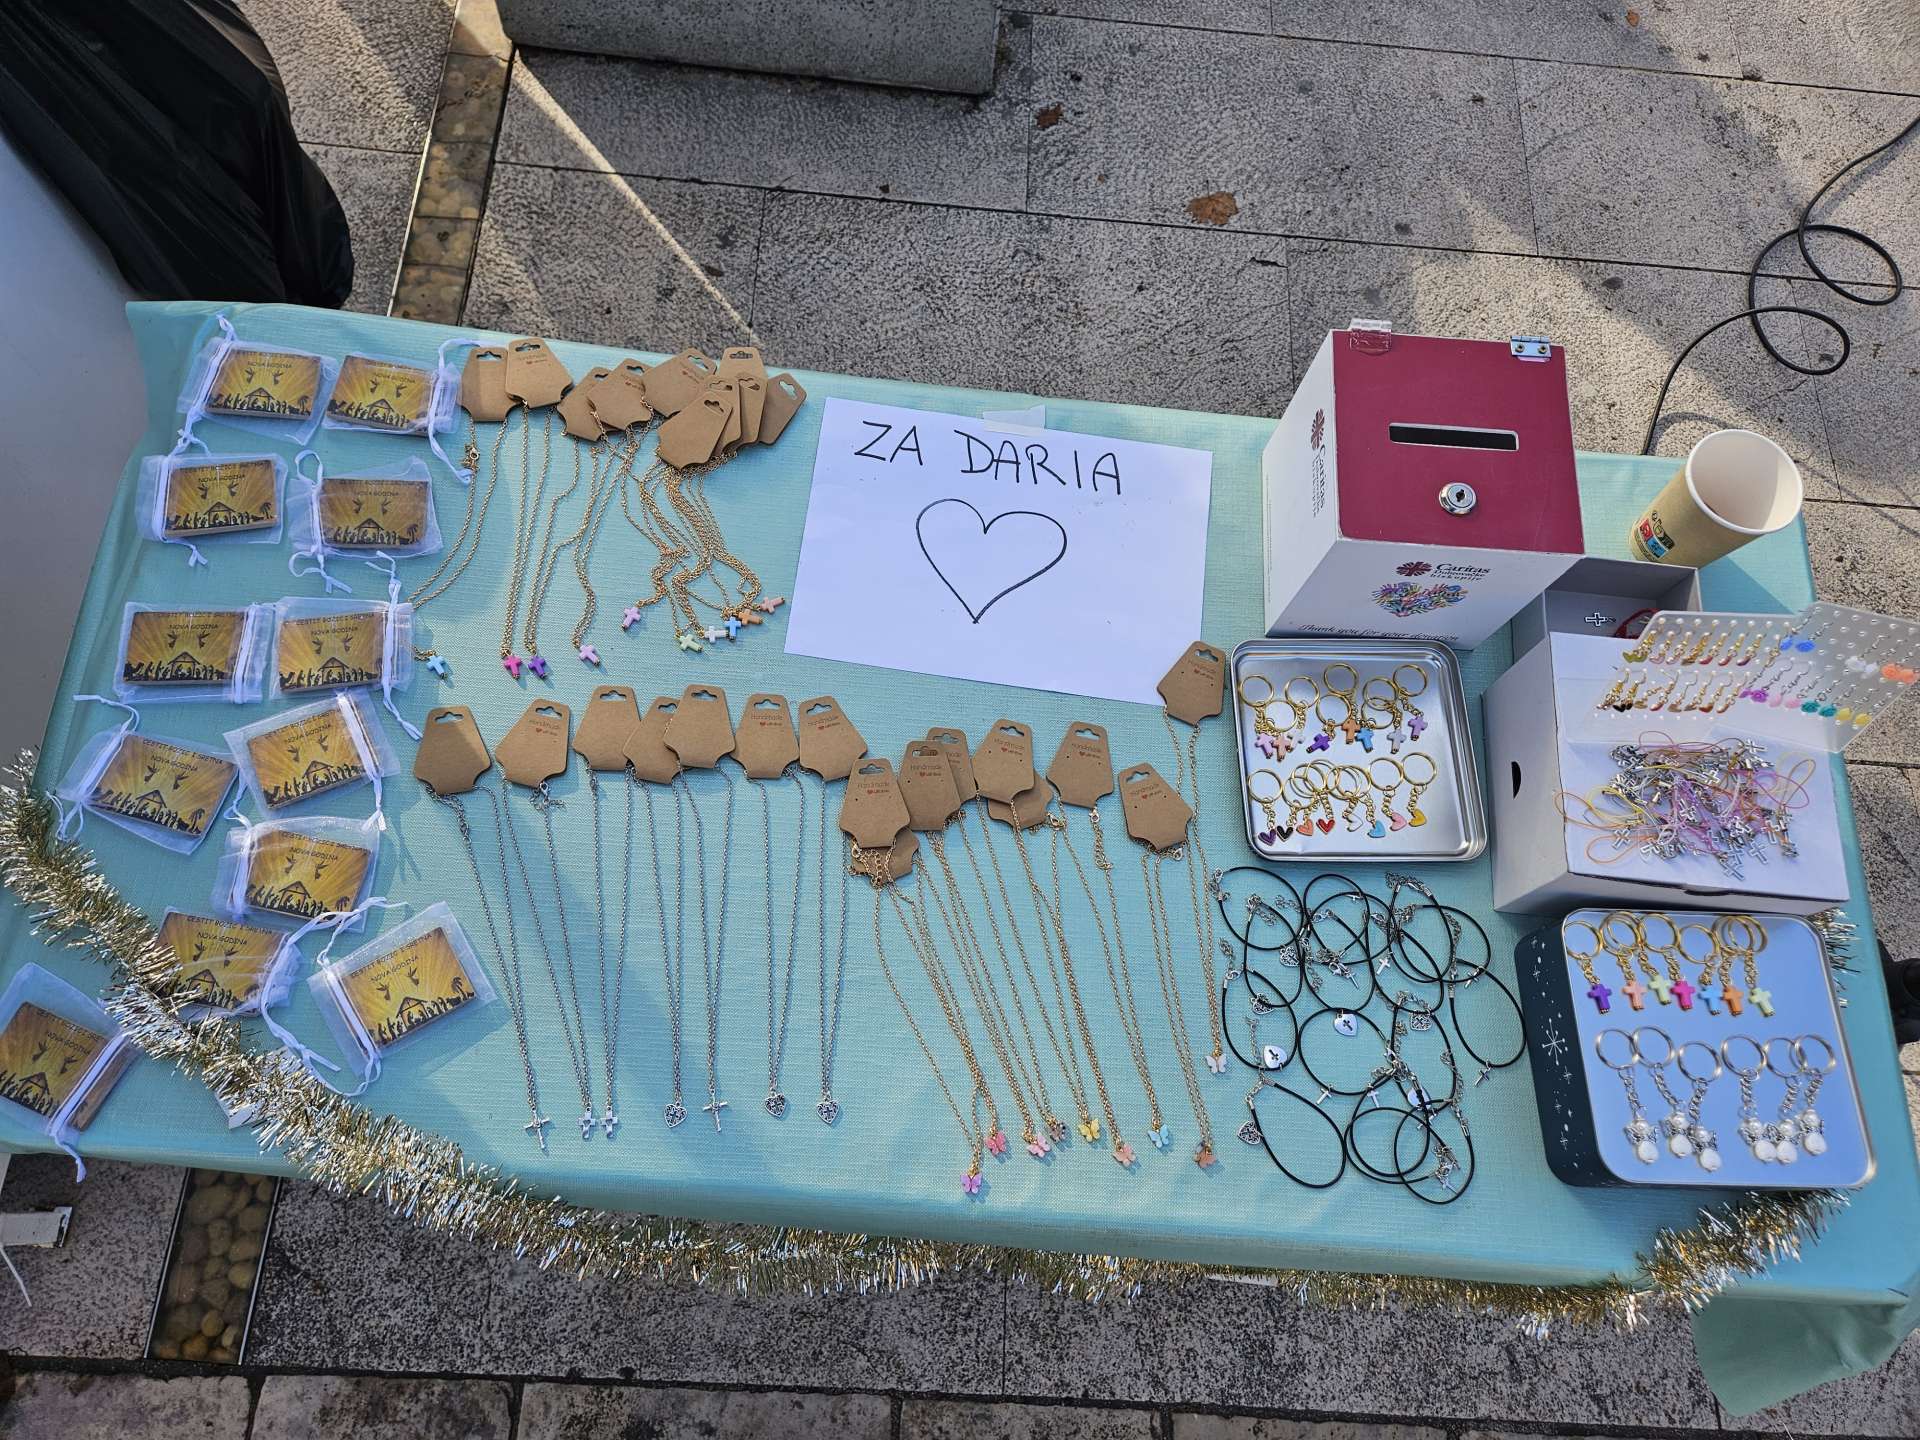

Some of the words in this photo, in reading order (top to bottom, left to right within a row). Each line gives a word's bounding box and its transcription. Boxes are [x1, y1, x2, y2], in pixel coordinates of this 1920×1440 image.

[854, 420, 923, 466] ZA
[954, 430, 1122, 496] DARIA
[1436, 563, 1490, 574] Caritas
